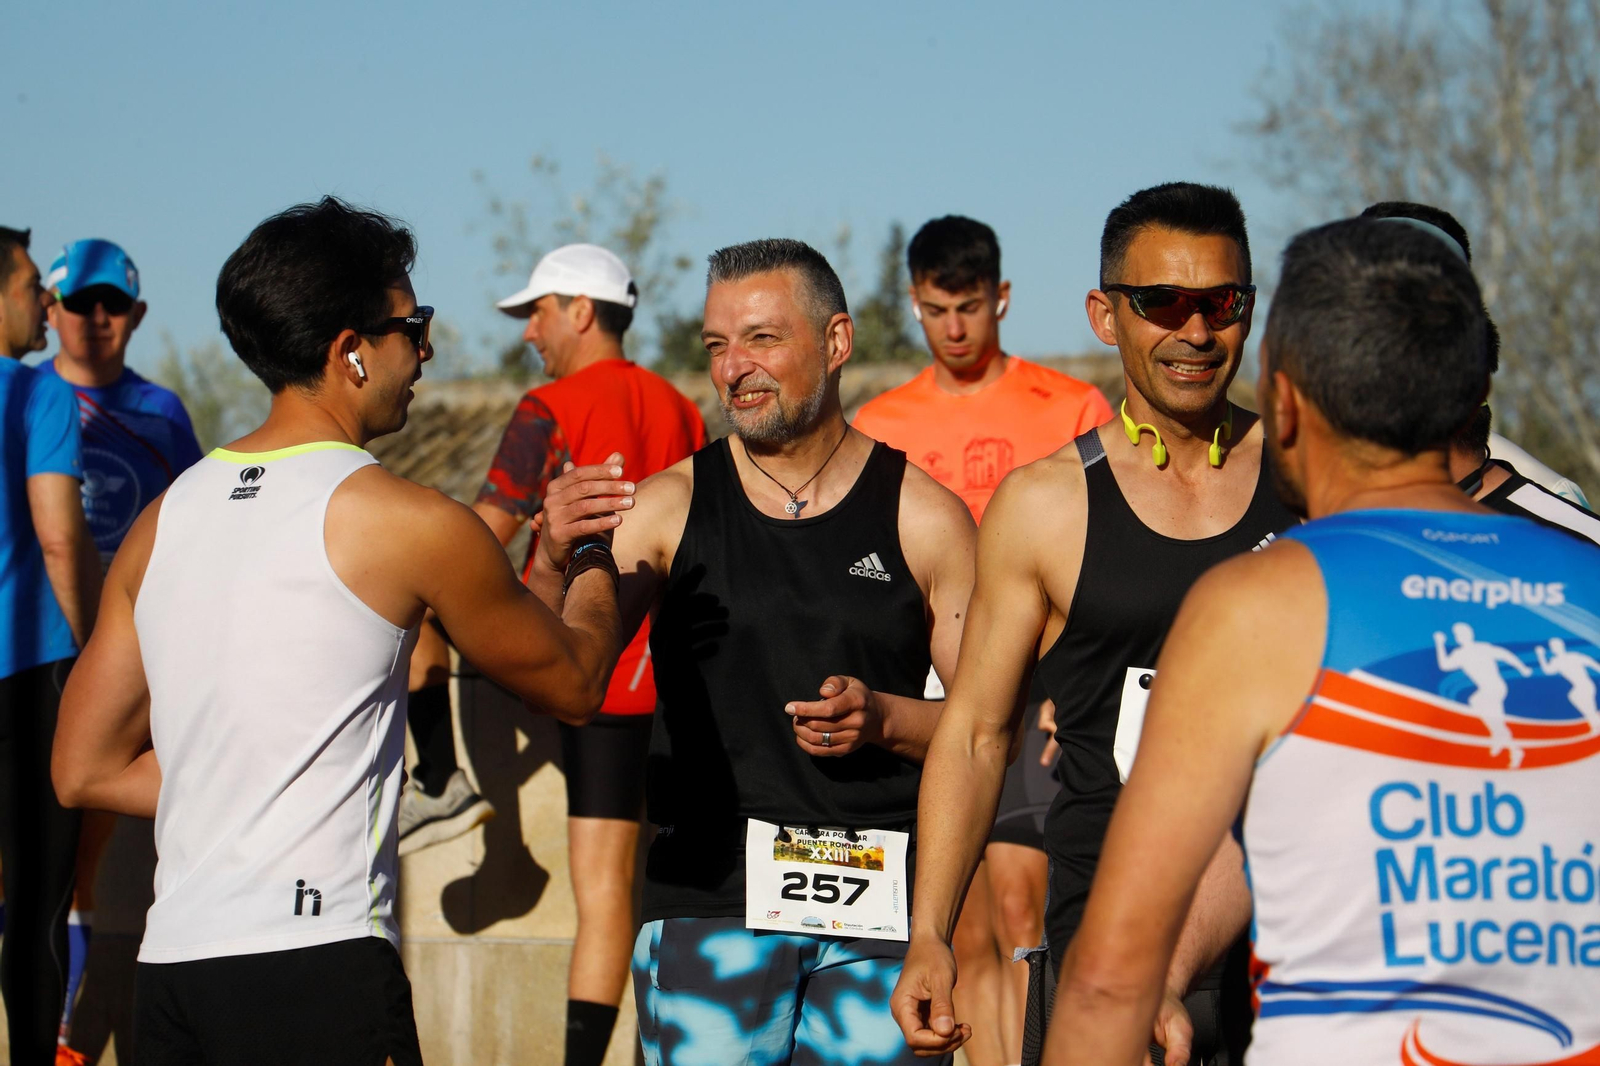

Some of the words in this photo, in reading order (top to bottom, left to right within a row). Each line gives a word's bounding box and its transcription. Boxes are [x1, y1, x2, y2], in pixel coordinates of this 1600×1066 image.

[849, 566, 892, 582] adidas
[1401, 574, 1566, 609] enerplus
[1369, 780, 1525, 841] Club
[797, 838, 828, 847] PUENTE
[830, 841, 864, 851] ROMANO
[781, 872, 870, 906] 257
[1375, 842, 1600, 905] Marató
[1381, 910, 1600, 967] Lucena
